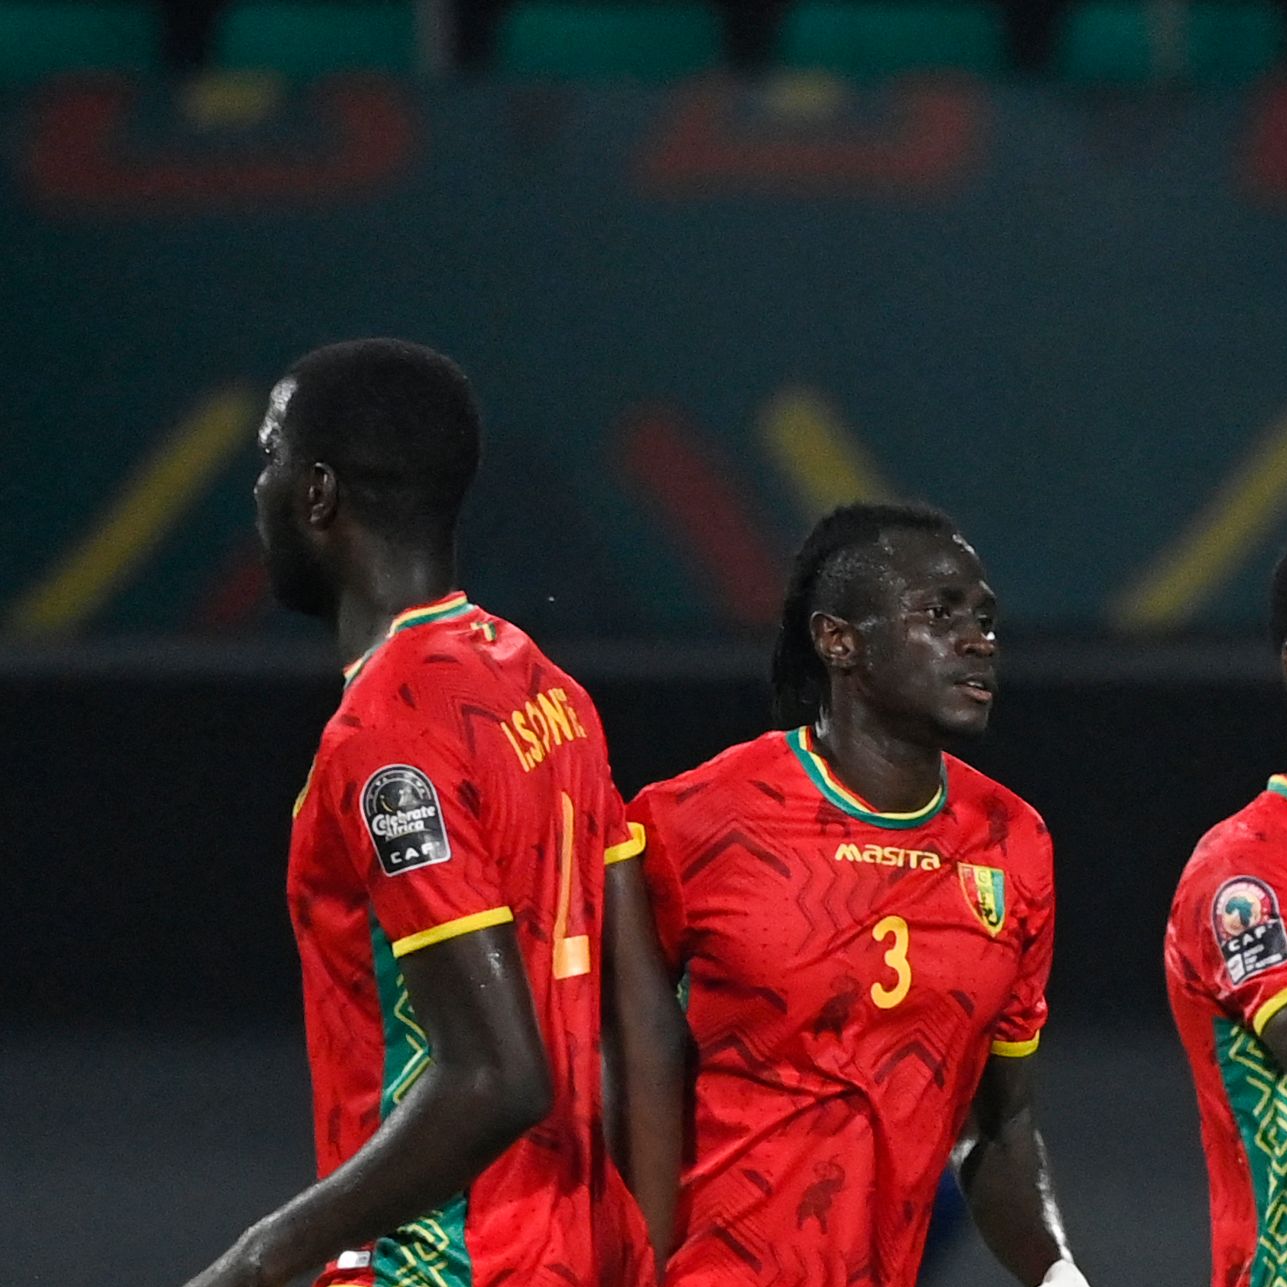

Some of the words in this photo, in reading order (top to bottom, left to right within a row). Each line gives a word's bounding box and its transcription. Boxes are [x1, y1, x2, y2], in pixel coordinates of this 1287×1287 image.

[390, 842, 434, 864] CAF
[1228, 925, 1266, 952] CAF
[871, 915, 912, 1009] 3
